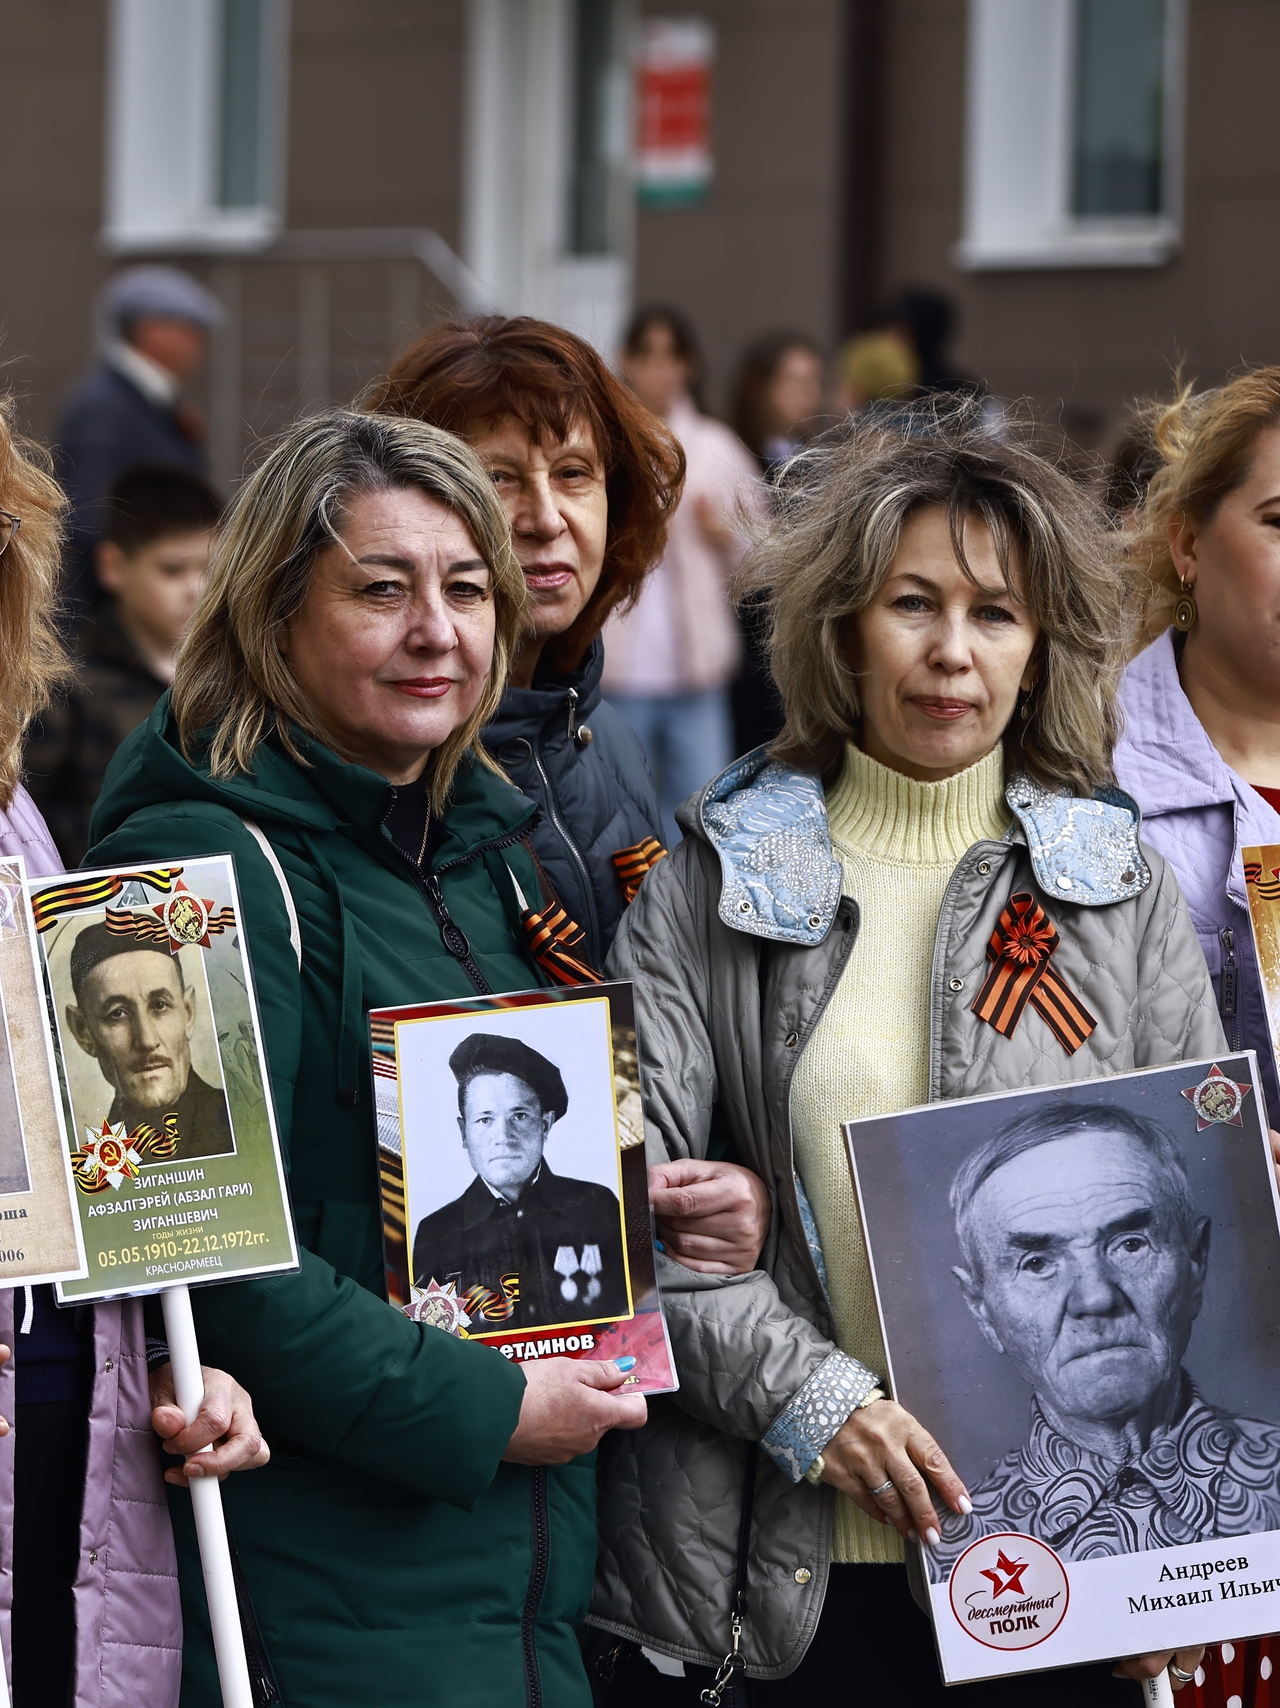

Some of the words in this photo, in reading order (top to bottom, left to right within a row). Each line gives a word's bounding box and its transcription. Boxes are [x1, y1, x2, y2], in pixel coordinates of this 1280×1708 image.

[133, 1168, 205, 1190] ЗИГАНШИН
[87, 1191, 171, 1217] АФЗАЛГЭРЕЙ
[173, 1186, 217, 1207] (АБЗАЛ
[219, 1182, 253, 1199] ГАРИ)
[133, 1208, 219, 1232] ЗИГАНШЕВИЧ
[98, 1230, 270, 1267] 05.05.1910-22.12.1972гг.
[145, 1255, 223, 1277] КРАСНОАРМЕЕЦ
[490, 1333, 595, 1360] етдинов
[1158, 1556, 1249, 1583] Андреев
[965, 1591, 1061, 1621] бессмертный
[1127, 1590, 1214, 1615] Михаил
[989, 1615, 1040, 1635] ПОЛК
